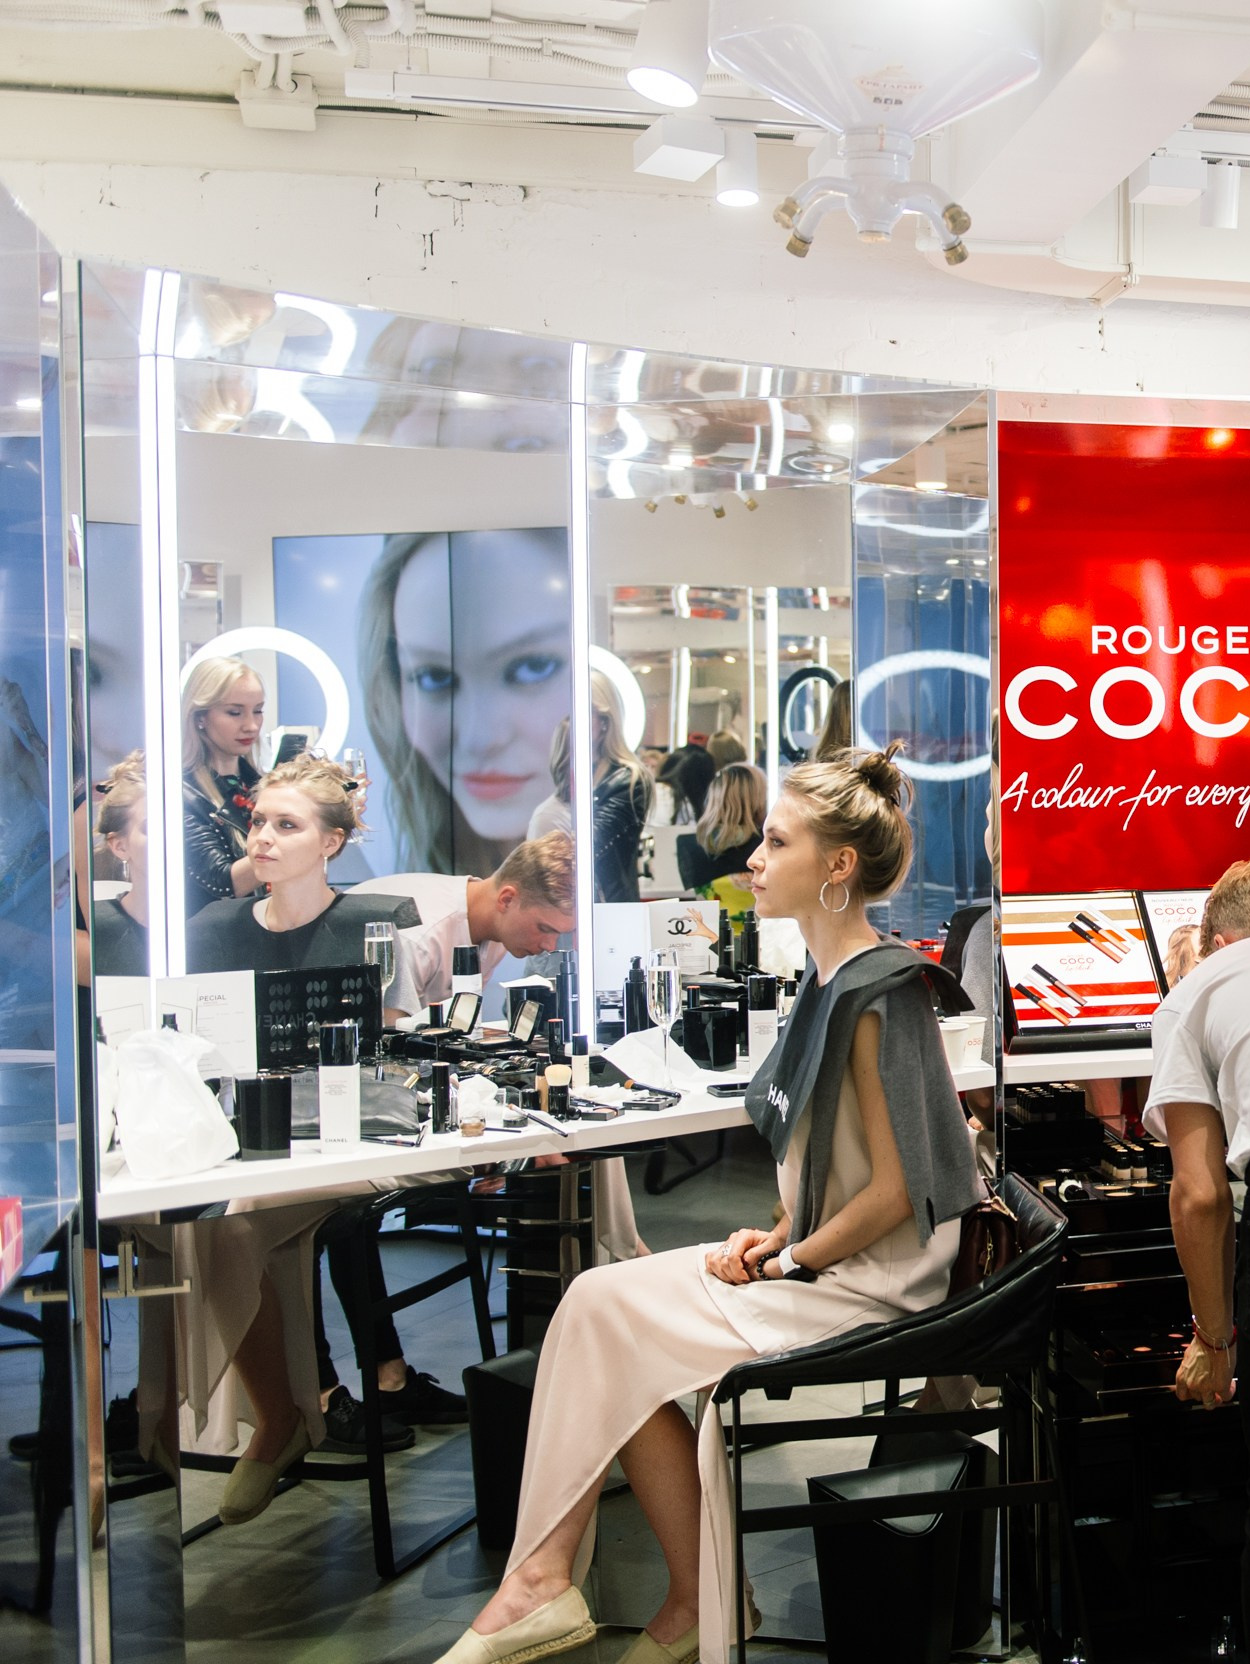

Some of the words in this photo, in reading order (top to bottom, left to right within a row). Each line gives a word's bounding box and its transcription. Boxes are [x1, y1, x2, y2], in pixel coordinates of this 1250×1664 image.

[1091, 625, 1250, 655] ROUGE
[1000, 771, 1029, 812] A
[1031, 762, 1126, 809] colour
[1119, 769, 1183, 832] for
[1154, 907, 1197, 916] COCO
[1059, 957, 1095, 965] COCO
[198, 994, 227, 1002] PECIAL
